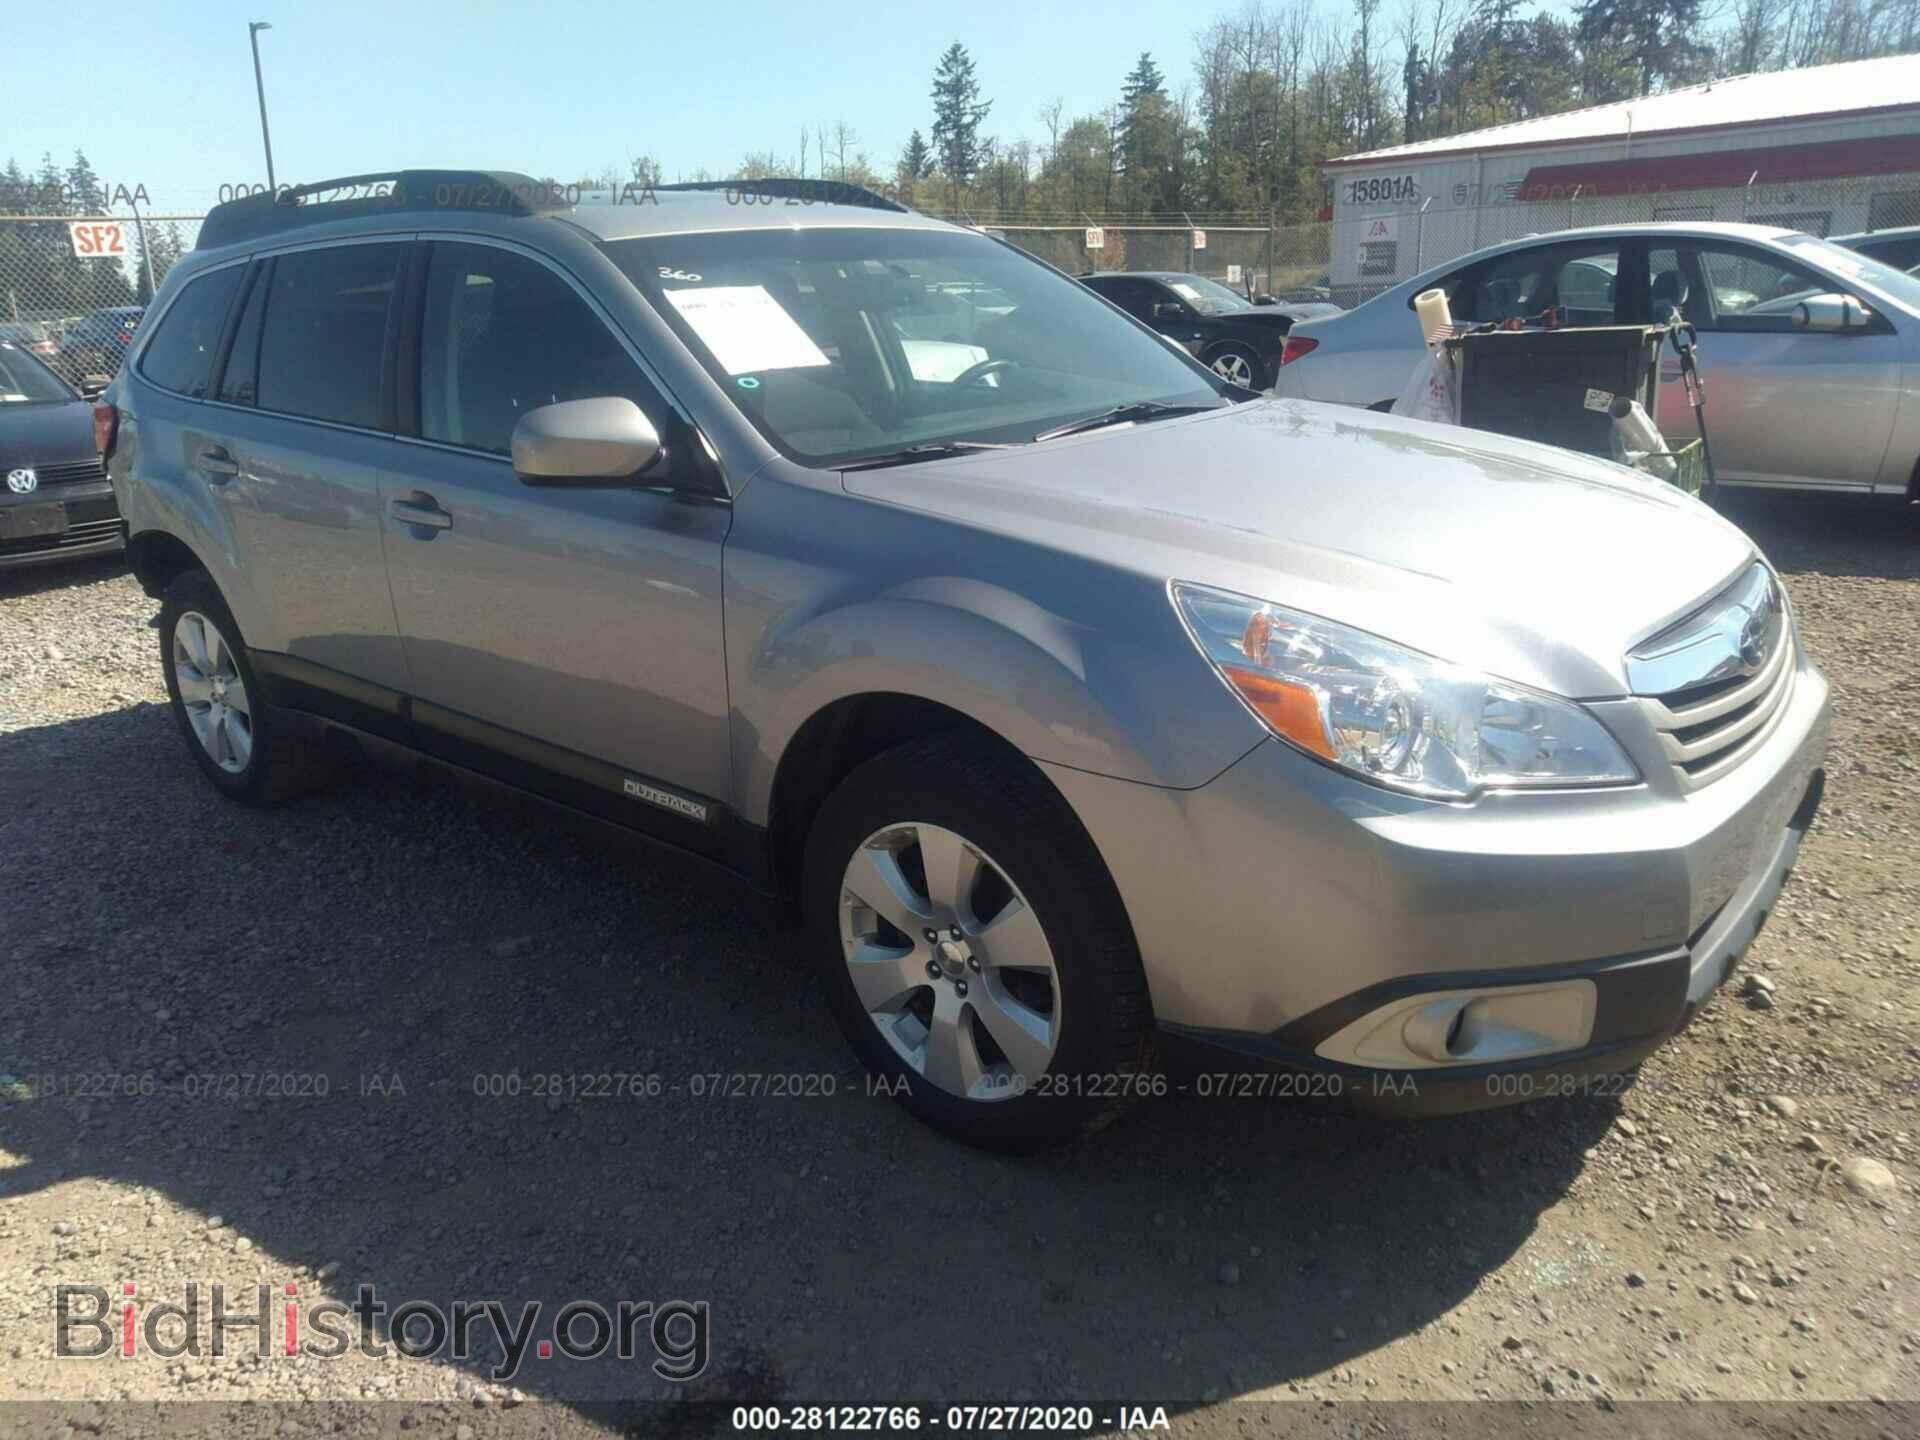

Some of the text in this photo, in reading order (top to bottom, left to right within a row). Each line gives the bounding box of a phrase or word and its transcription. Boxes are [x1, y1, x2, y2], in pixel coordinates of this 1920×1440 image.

[1352, 176, 1415, 202] 15801A
[75, 225, 125, 254] SF2
[658, 266, 702, 282] 360
[624, 780, 705, 819] OUTBACK
